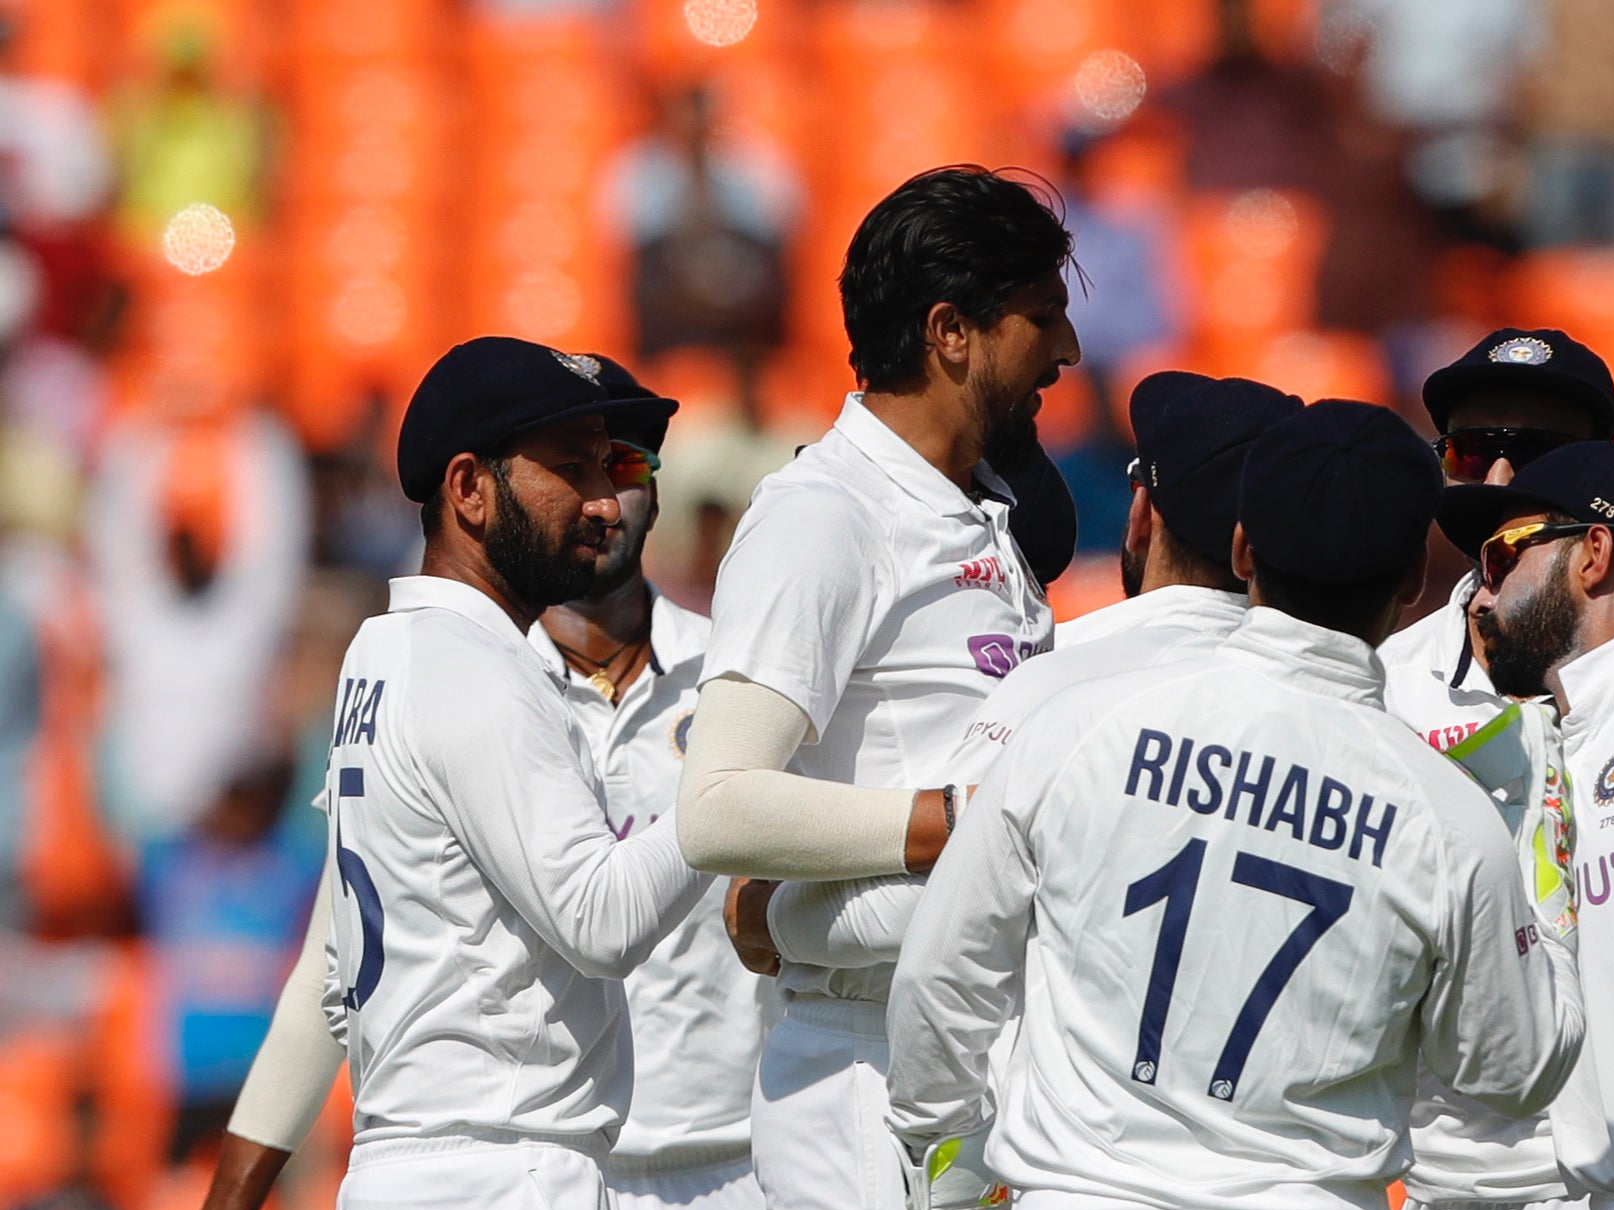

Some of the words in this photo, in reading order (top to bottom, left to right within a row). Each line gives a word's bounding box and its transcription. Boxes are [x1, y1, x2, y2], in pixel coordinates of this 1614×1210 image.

[336, 767, 386, 1012] 5
[1124, 728, 1398, 869] RISHABH
[1122, 838, 1354, 1102] 17
